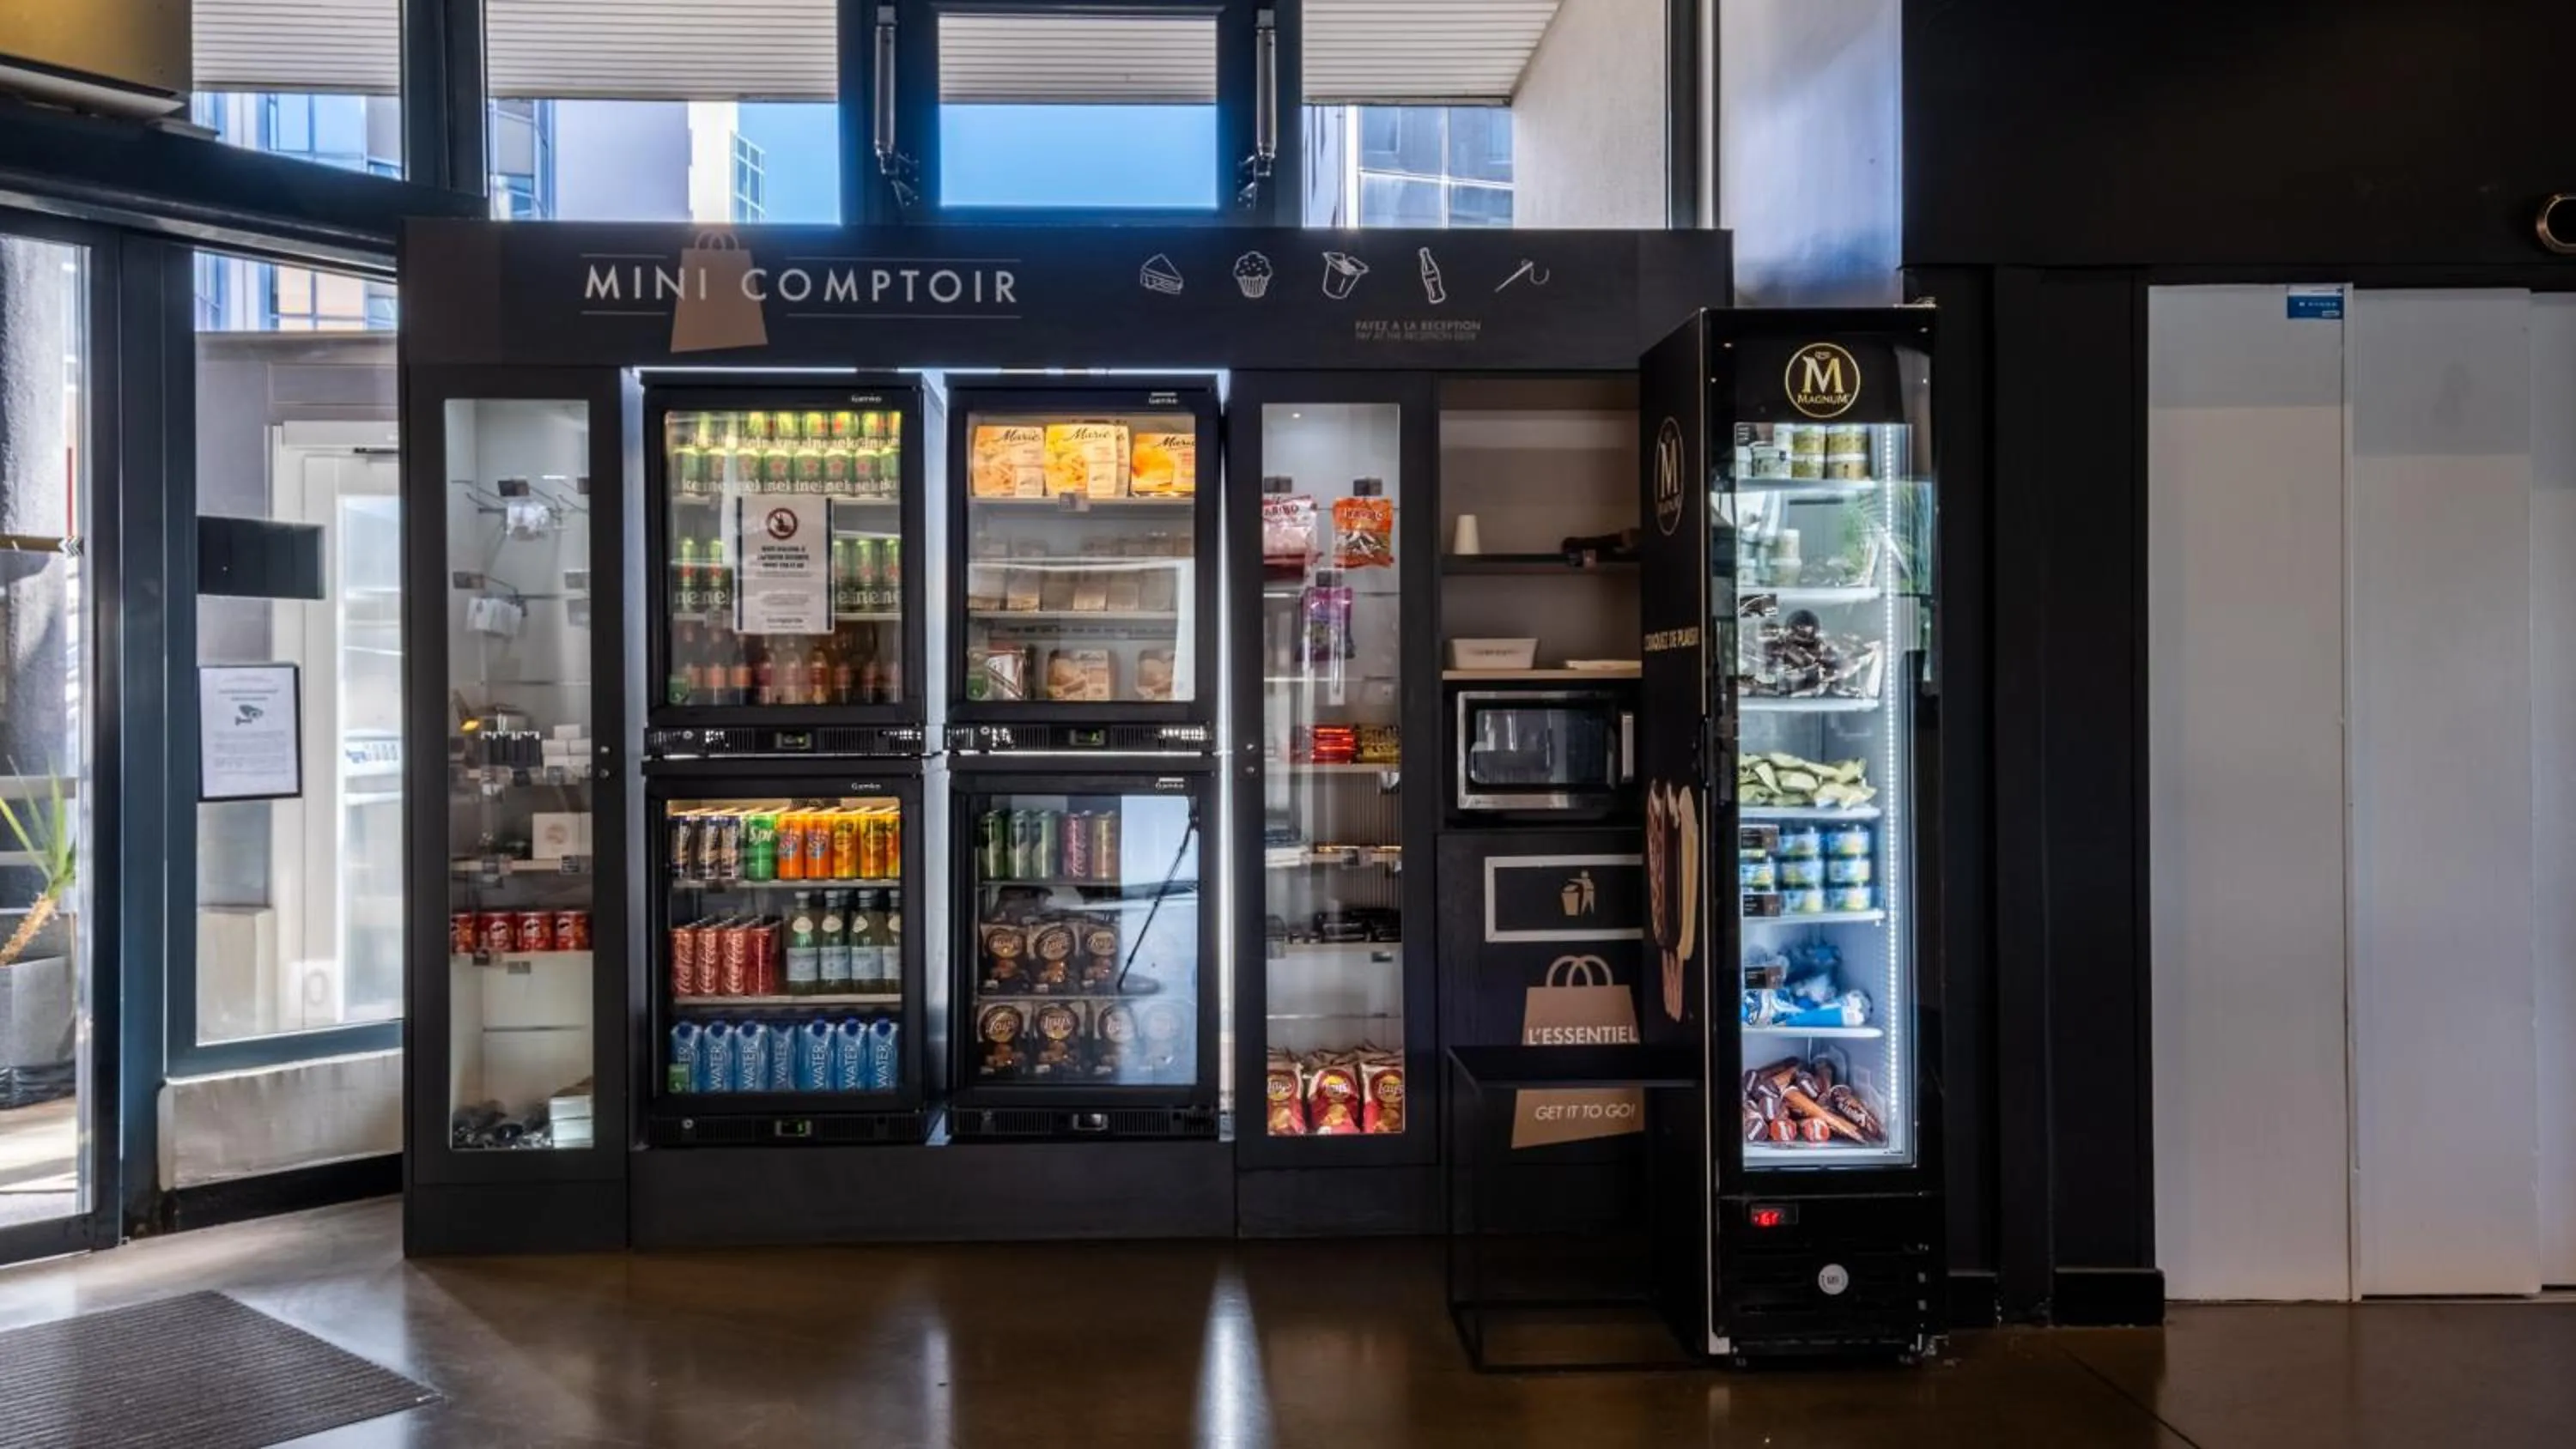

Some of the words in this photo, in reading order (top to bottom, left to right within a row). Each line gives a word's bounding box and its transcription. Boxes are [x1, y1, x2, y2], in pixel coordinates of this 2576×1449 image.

[584, 264, 708, 300] MINI
[740, 267, 1018, 304] COMPTOIR
[1796, 393, 1849, 403] MAGNUM
[1263, 505, 1299, 517] ARIBO
[1528, 1025, 1638, 1045] L'ESSENTIEL
[710, 1045, 723, 1090] WATER
[742, 1043, 757, 1090] WATER
[812, 1045, 826, 1089] WATER
[844, 1044, 858, 1089] WATER
[876, 1044, 890, 1088] WATER
[1534, 1105, 1561, 1120] GET
[1566, 1105, 1580, 1119] IT
[1582, 1104, 1602, 1119] TO
[1605, 1103, 1636, 1119] GO!
